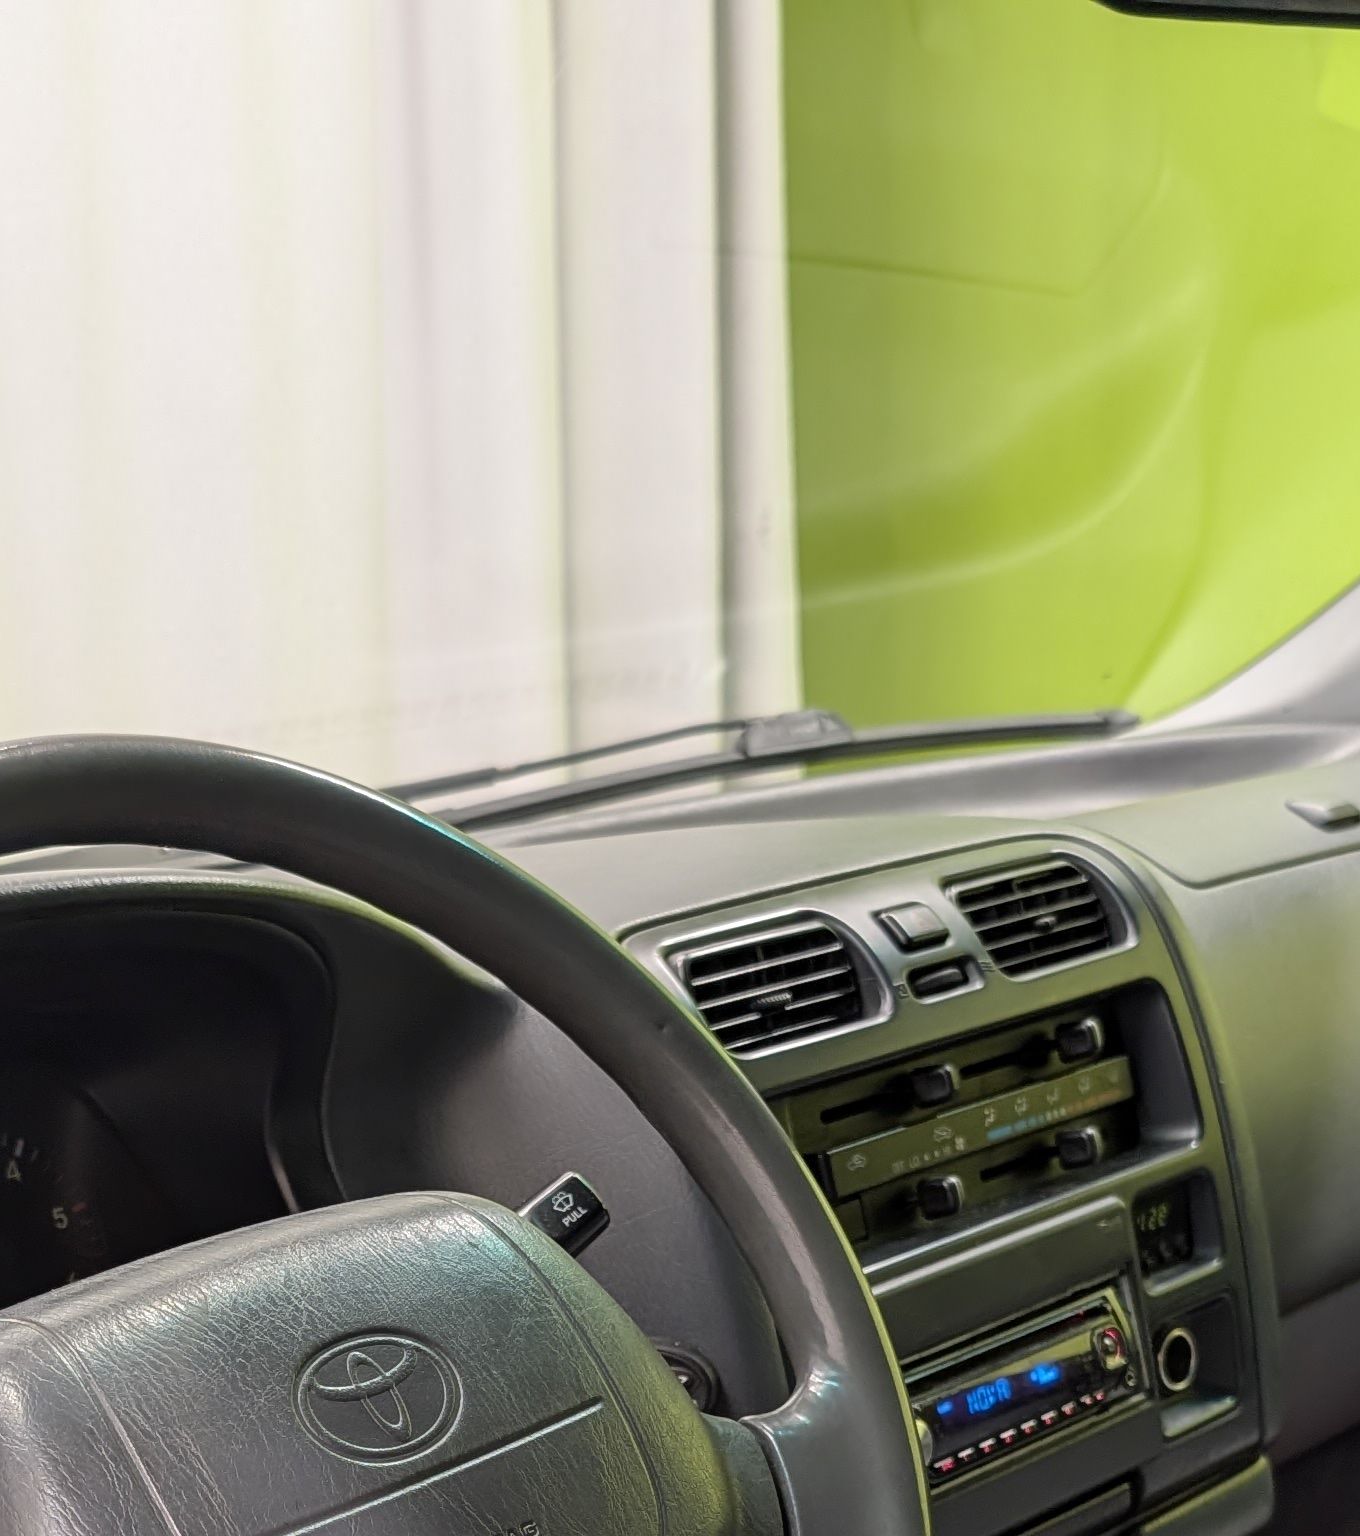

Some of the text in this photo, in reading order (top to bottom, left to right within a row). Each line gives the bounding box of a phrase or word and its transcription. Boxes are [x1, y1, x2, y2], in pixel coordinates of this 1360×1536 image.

[6, 1159, 22, 1181] 4
[52, 1207, 68, 1229] 5
[561, 1206, 589, 1228] PULL
